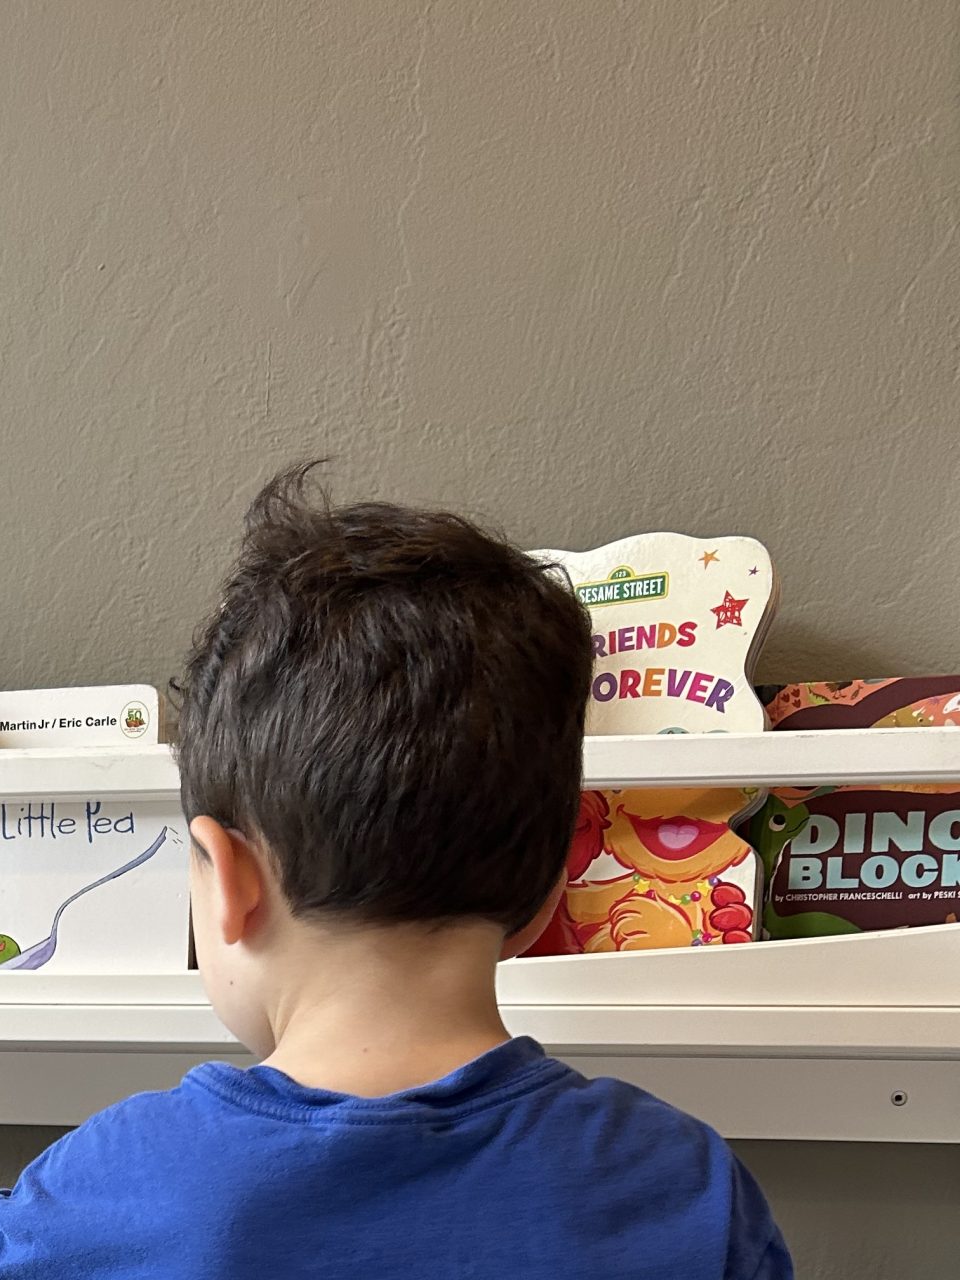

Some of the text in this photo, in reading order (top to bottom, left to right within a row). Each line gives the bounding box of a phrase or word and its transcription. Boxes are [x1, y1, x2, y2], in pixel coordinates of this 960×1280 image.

[579, 578, 663, 603] SESAME STREET
[590, 622, 698, 657] RIENDS
[592, 668, 735, 714] OREVER
[0, 721, 36, 732] Martin
[38, 719, 50, 730] Jr
[59, 717, 82, 728] Eric
[85, 716, 117, 727] Carle
[1, 802, 134, 843] Little Pea
[775, 894, 784, 902] by
[785, 893, 838, 901] CHRISTOPHER
[840, 891, 902, 900] FRANCESCHELLI
[922, 891, 932, 900] by
[933, 890, 956, 899] PESKI
